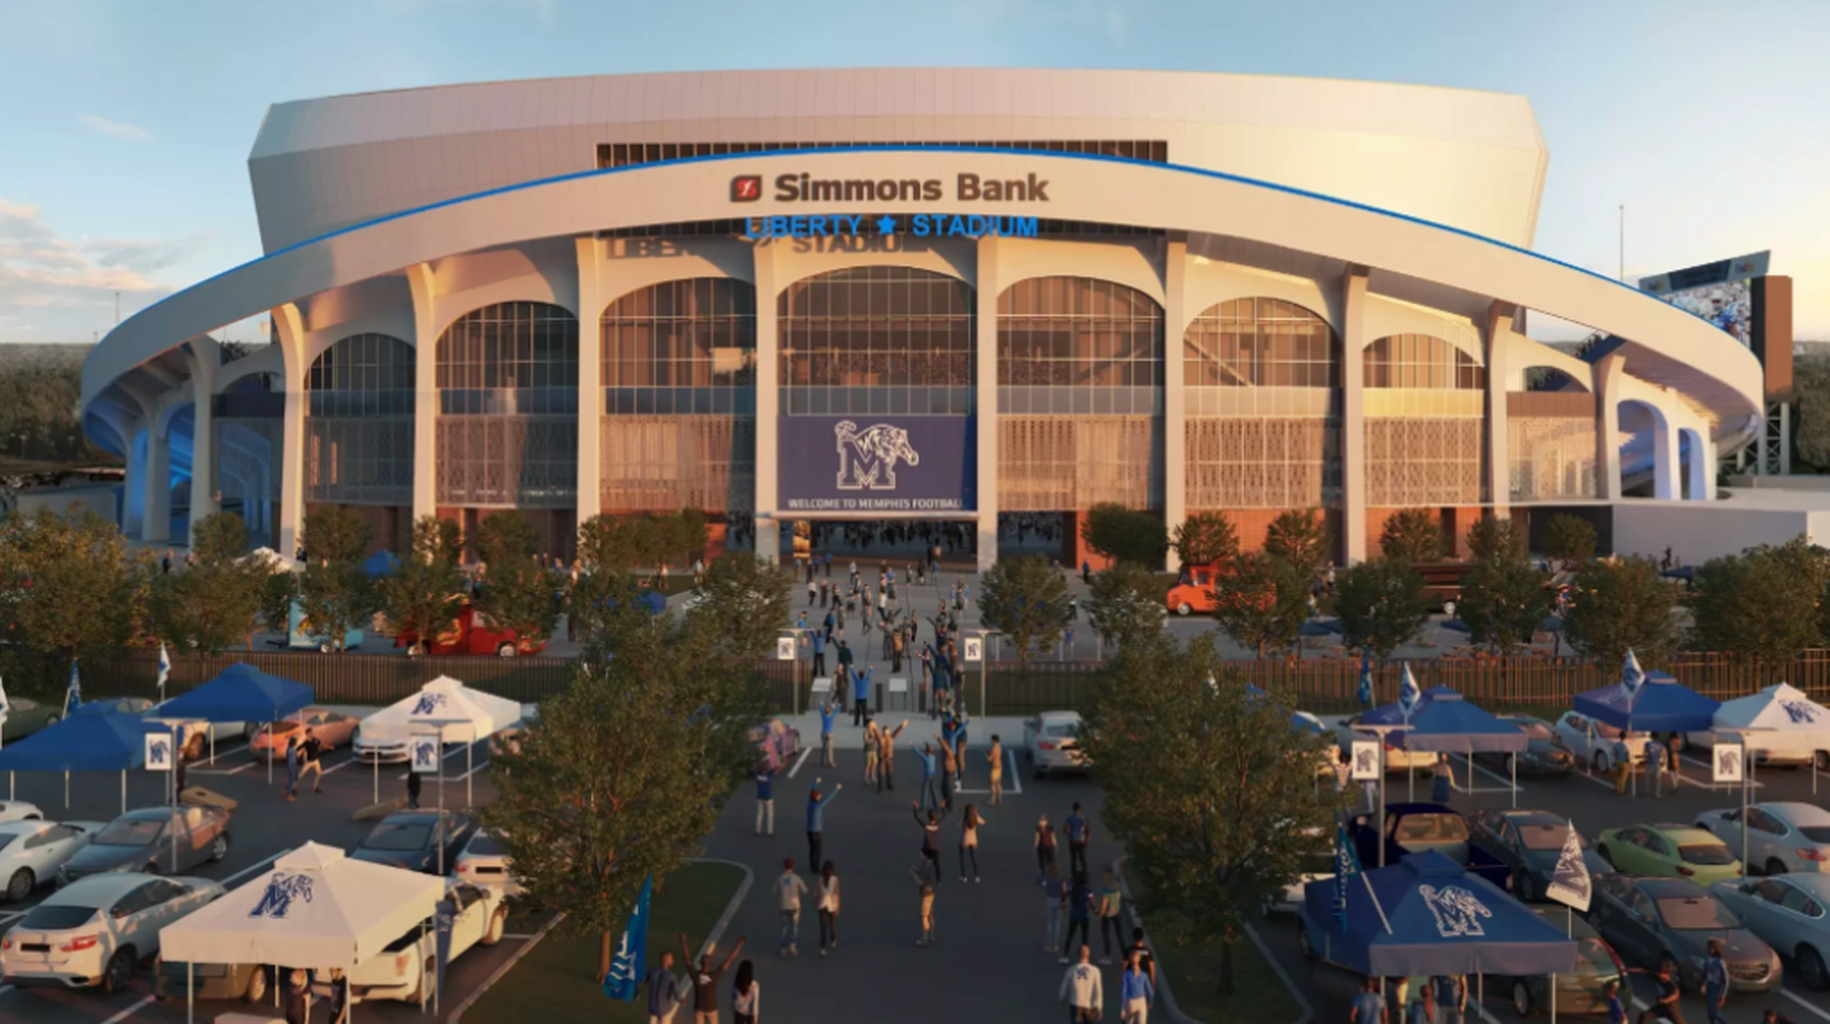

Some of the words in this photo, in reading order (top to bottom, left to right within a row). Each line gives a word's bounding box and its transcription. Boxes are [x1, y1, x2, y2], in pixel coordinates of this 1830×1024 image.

[773, 172, 943, 202] Simmons
[956, 172, 1050, 202] Bank
[744, 215, 863, 239] LIBERTY
[912, 214, 1038, 238] STADIUM
[788, 498, 840, 509] WELCOME
[843, 498, 856, 509] TO
[859, 498, 910, 509] MEMPHIS
